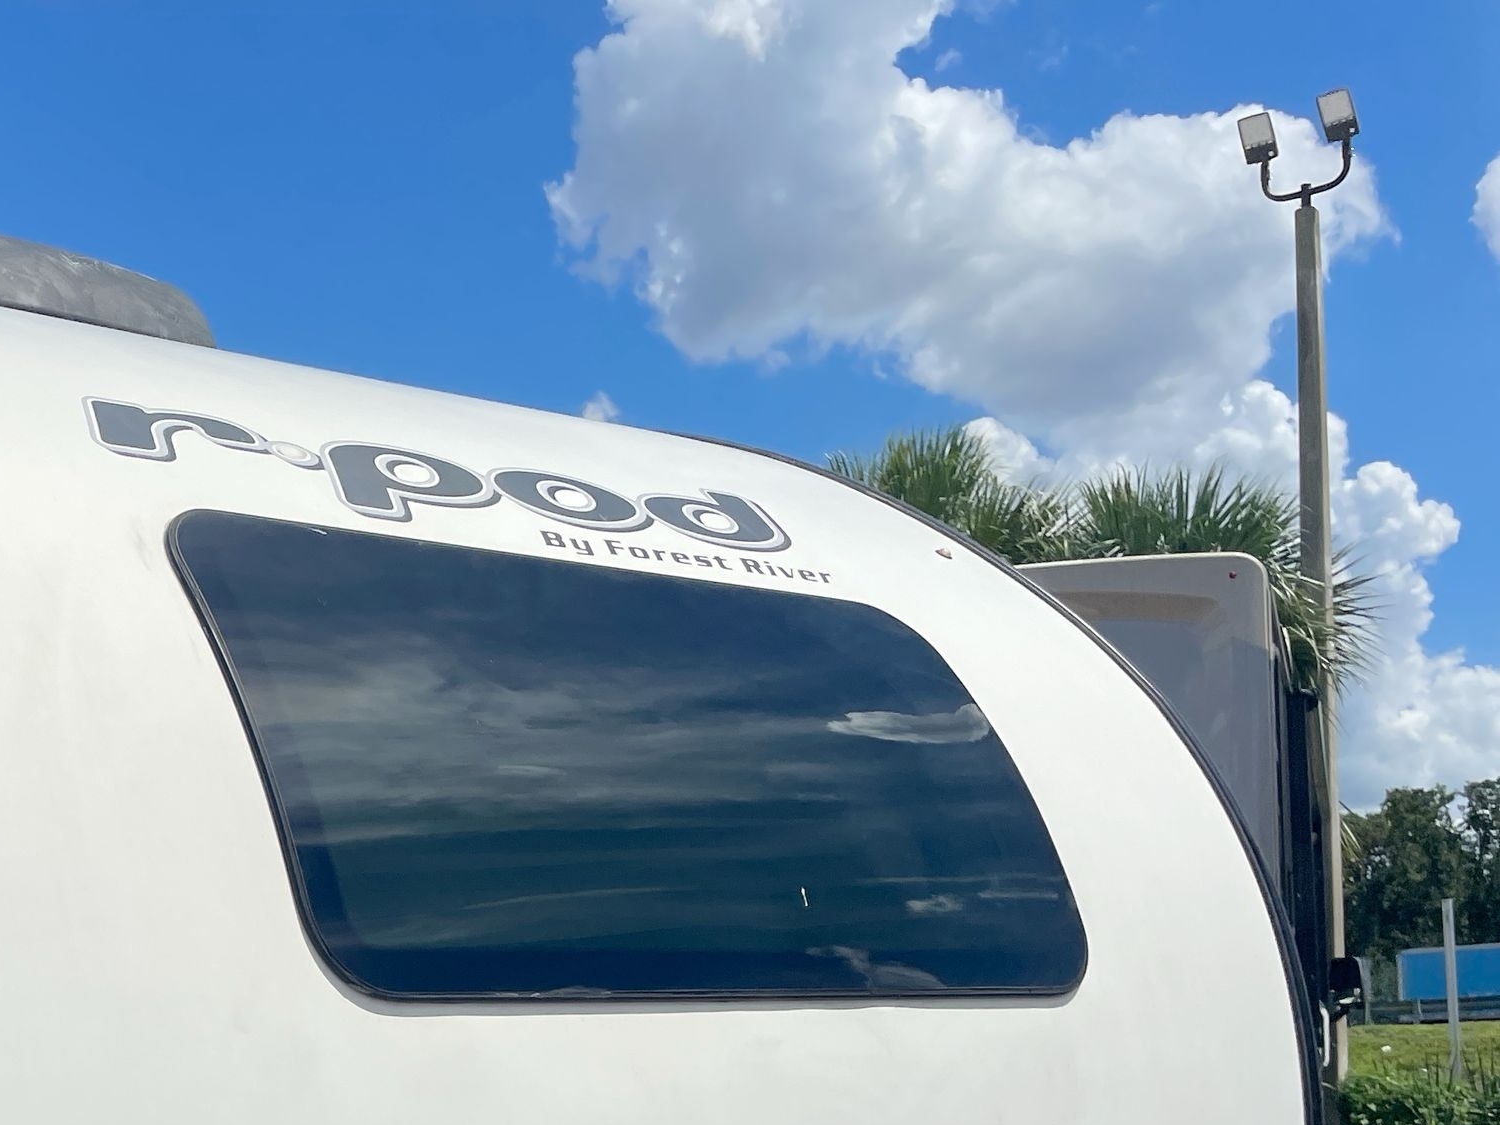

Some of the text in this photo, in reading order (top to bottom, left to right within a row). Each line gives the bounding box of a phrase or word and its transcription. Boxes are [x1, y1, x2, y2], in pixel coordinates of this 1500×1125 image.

[539, 530, 834, 585] By Forest River
